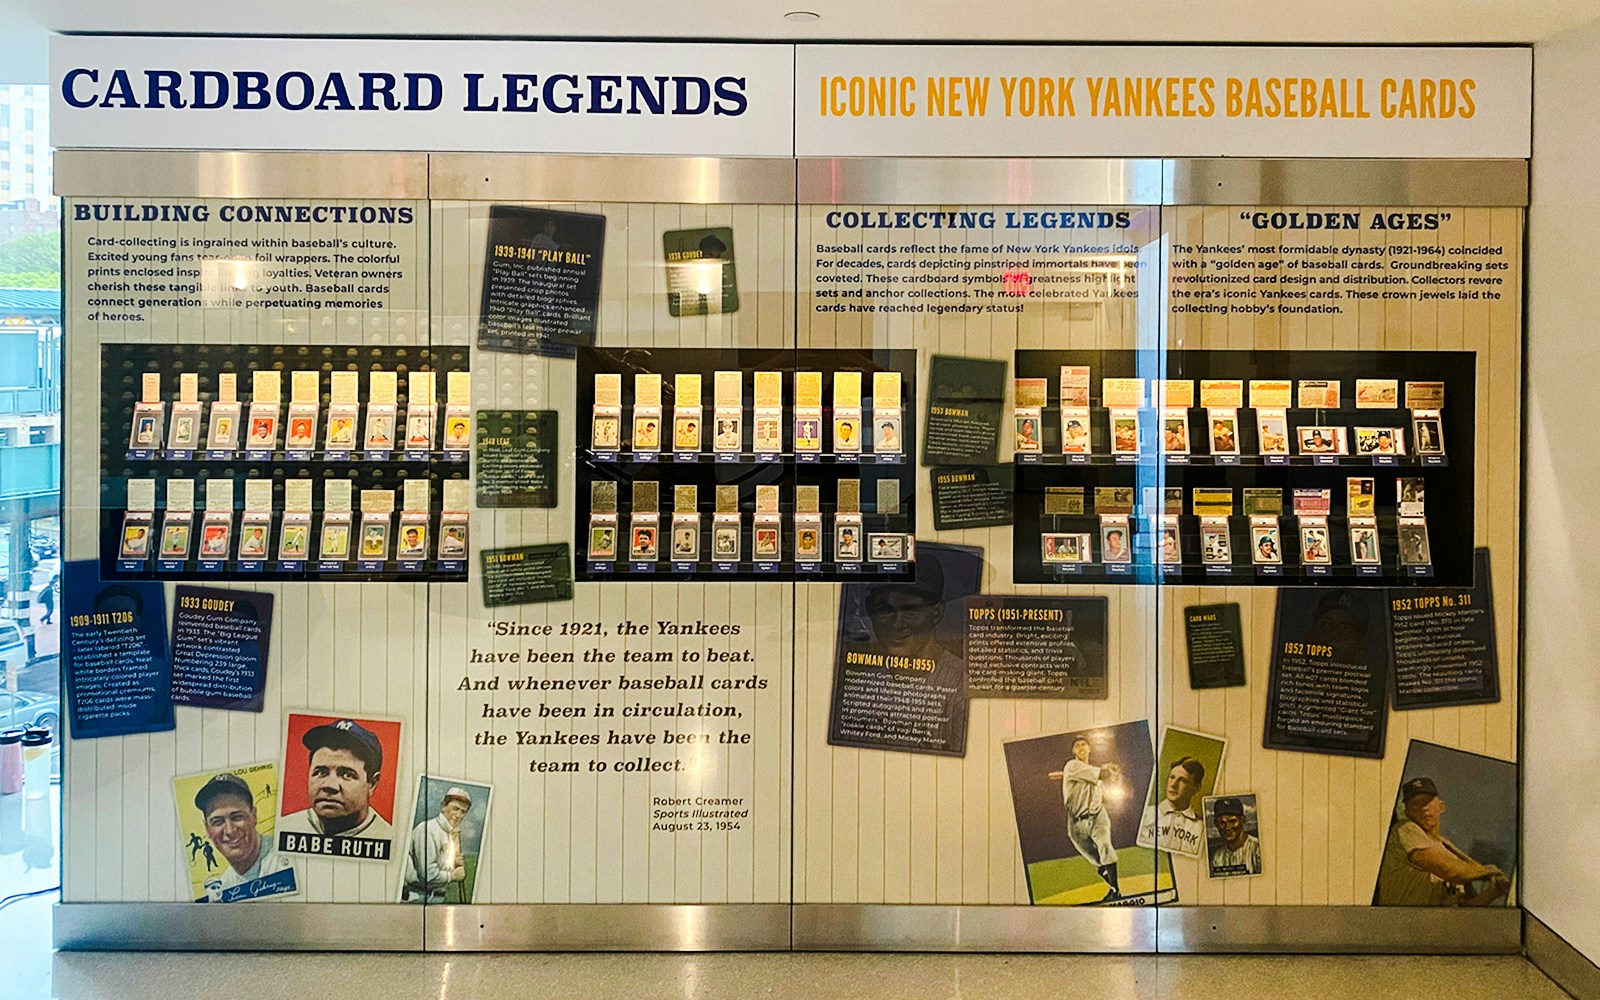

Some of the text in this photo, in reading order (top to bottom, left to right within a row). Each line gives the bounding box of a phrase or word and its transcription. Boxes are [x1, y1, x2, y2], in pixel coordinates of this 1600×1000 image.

[61, 68, 748, 117] CARDBOARD LEGENDS
[820, 76, 1476, 119] ICONIC NEW YORK YANKEES BASEBALL CARDS
[74, 204, 413, 224] BUILDING CONNECTIONS
[826, 212, 1130, 229] COLLECTING LEGENDS
[1240, 212, 1451, 230] "GOLDEN AGES"
[88, 237, 396, 249] Card-collecting is ingrained within baseball's culture.
[816, 244, 1141, 253] Baseball cards reflect the fame of New York Yankees idols.
[88, 252, 128, 262] Excited
[132, 254, 167, 264] young
[171, 252, 194, 262] fans
[255, 253, 271, 262] foil
[275, 254, 330, 265] wrappers.
[334, 254, 353, 263] The
[357, 254, 399, 264] colorful
[495, 245, 591, 265] 1939-1941 "PLAY BALL"
[1173, 245, 1502, 257] The Yankees' most formidable dynasty (1921-1964) coincided
[1172, 260, 1197, 269] with
[1210, 260, 1255, 271] "golden
[1258, 260, 1284, 271] age"
[1288, 260, 1298, 269] of
[1302, 260, 1347, 269] baseball
[1351, 260, 1384, 269] cards.
[1391, 260, 1482, 271] Groundbreaking
[1485, 261, 1508, 270] sets
[88, 298, 382, 310] connect generations while perpetuating memories
[816, 303, 1024, 315] cards have reached legendary status!
[1172, 304, 1343, 315] collecting hobby's foundation.
[88, 312, 144, 321] of heroes.
[181, 597, 234, 611] 1933 GOUDEY
[1392, 595, 1471, 611] 1952 TOPPS No. 311
[70, 611, 133, 627] 1909-1911 T206
[969, 608, 1063, 622] TOPPS (1951-PRESENT)
[487, 621, 741, 637] "Since 1921, the Yankees
[470, 648, 754, 663] have been the team to beat.
[1285, 642, 1332, 657] 1952 TOPPS
[847, 652, 936, 673] BOWMAN (1948-1955)
[458, 675, 768, 690] And whenever baseball cards
[482, 703, 742, 718] have been in circulation,
[475, 731, 750, 745] the Yankees have been the
[234, 763, 273, 776] LOU GEHRIG
[529, 757, 694, 772] team to collect.
[653, 797, 743, 806] Robert Creamer
[653, 809, 748, 819] Sports Illustrated
[652, 822, 740, 832] August 23, 1954
[1173, 826, 1198, 845] YORK
[286, 834, 384, 859] BABE RUTH
